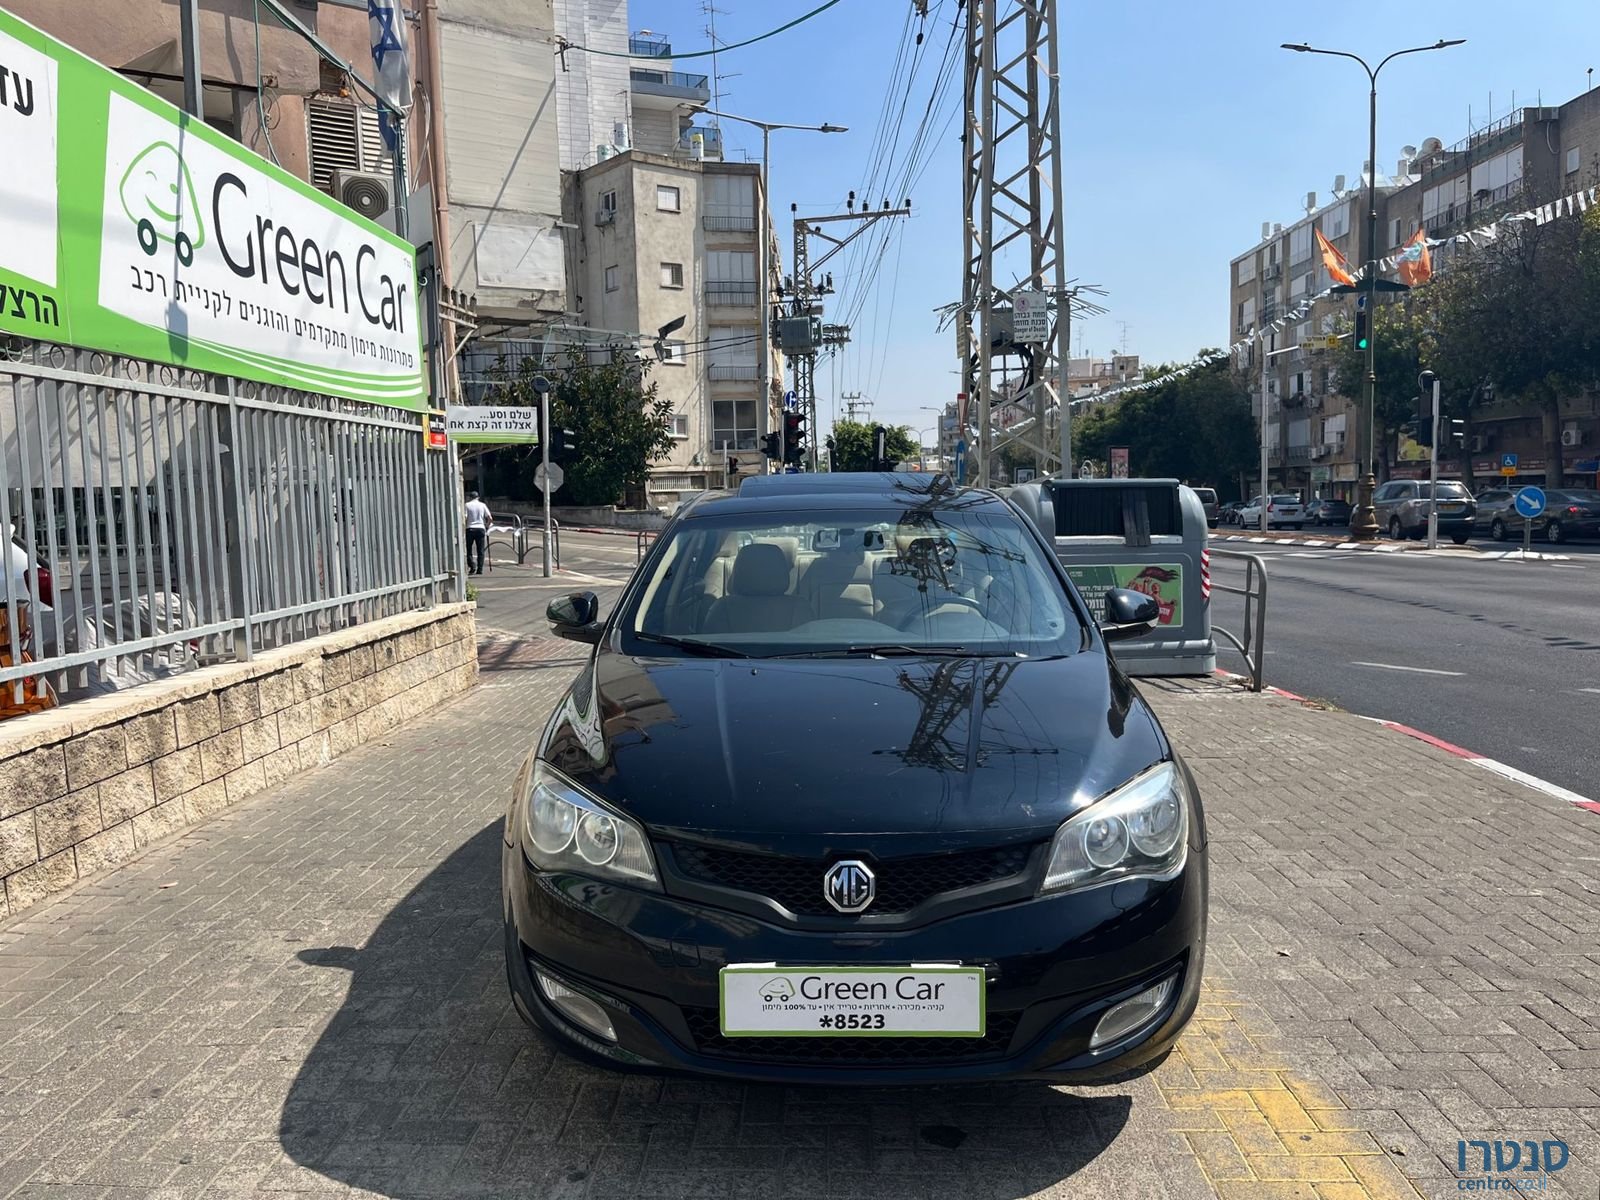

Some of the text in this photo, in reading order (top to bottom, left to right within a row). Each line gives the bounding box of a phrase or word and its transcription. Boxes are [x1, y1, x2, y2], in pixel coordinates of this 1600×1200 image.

[212, 172, 406, 333] Green Car
[130, 265, 414, 368] פתרונות מימון מתקדמים והוגנים לקניית רכב
[448, 420, 532, 431] אצלנו זה קצת אח
[510, 410, 532, 419] שלם
[831, 867, 868, 905] MG
[800, 976, 945, 1000] Green Car
[762, 1004, 782, 1012] מימון
